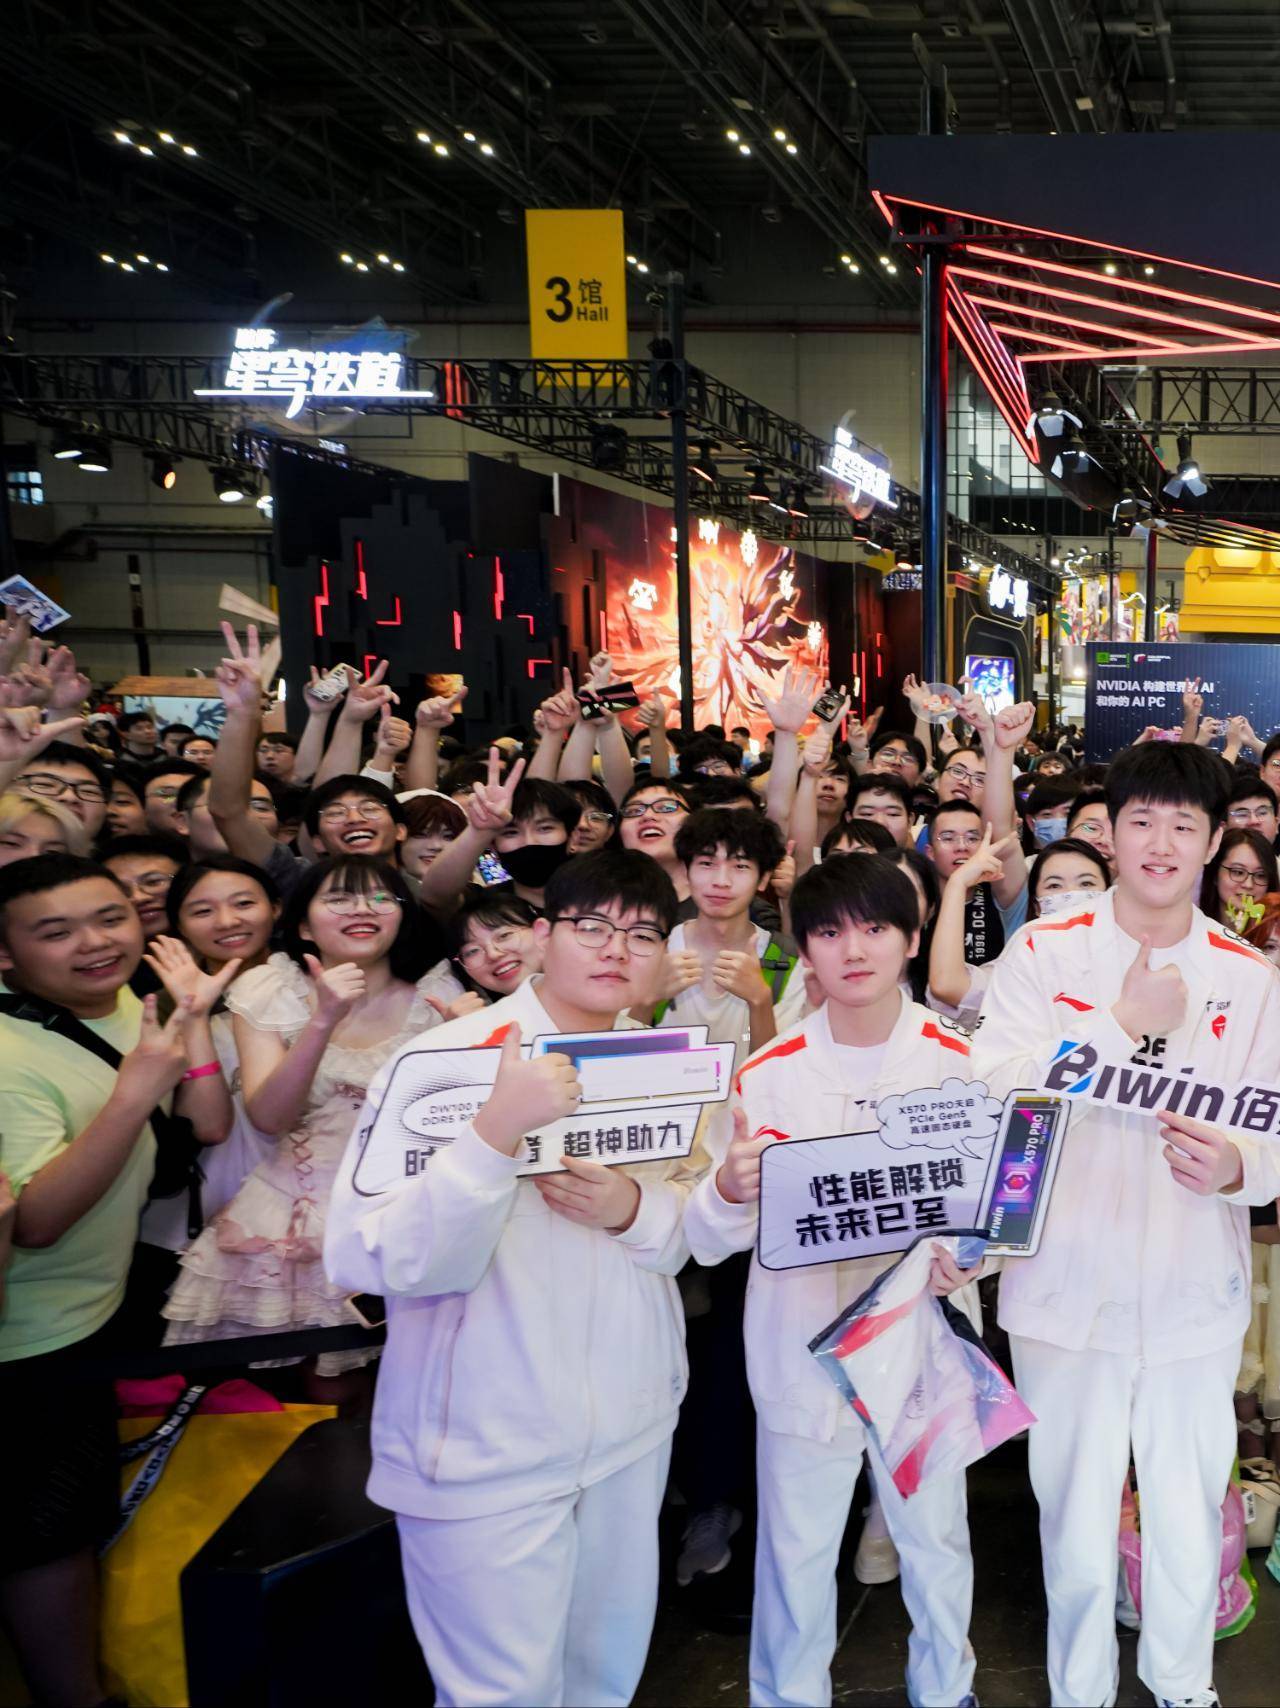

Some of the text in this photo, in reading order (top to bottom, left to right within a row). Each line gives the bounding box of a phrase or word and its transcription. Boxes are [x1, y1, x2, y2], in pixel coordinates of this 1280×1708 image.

[544, 276, 602, 323] 3 馆
[576, 306, 609, 322] Hall
[1096, 680, 1141, 692] NVIDIA
[1201, 682, 1215, 693] AI
[1096, 695, 1166, 708] 和你的 AI PC
[898, 1104, 927, 1115] X570
[909, 1110, 967, 1124] PCIe Gen5
[564, 1121, 682, 1158] 超神助力
[1022, 1114, 1044, 1165] X570 PRO
[809, 1157, 967, 1208] 性能解锁
[796, 1196, 950, 1247] 未来已至
